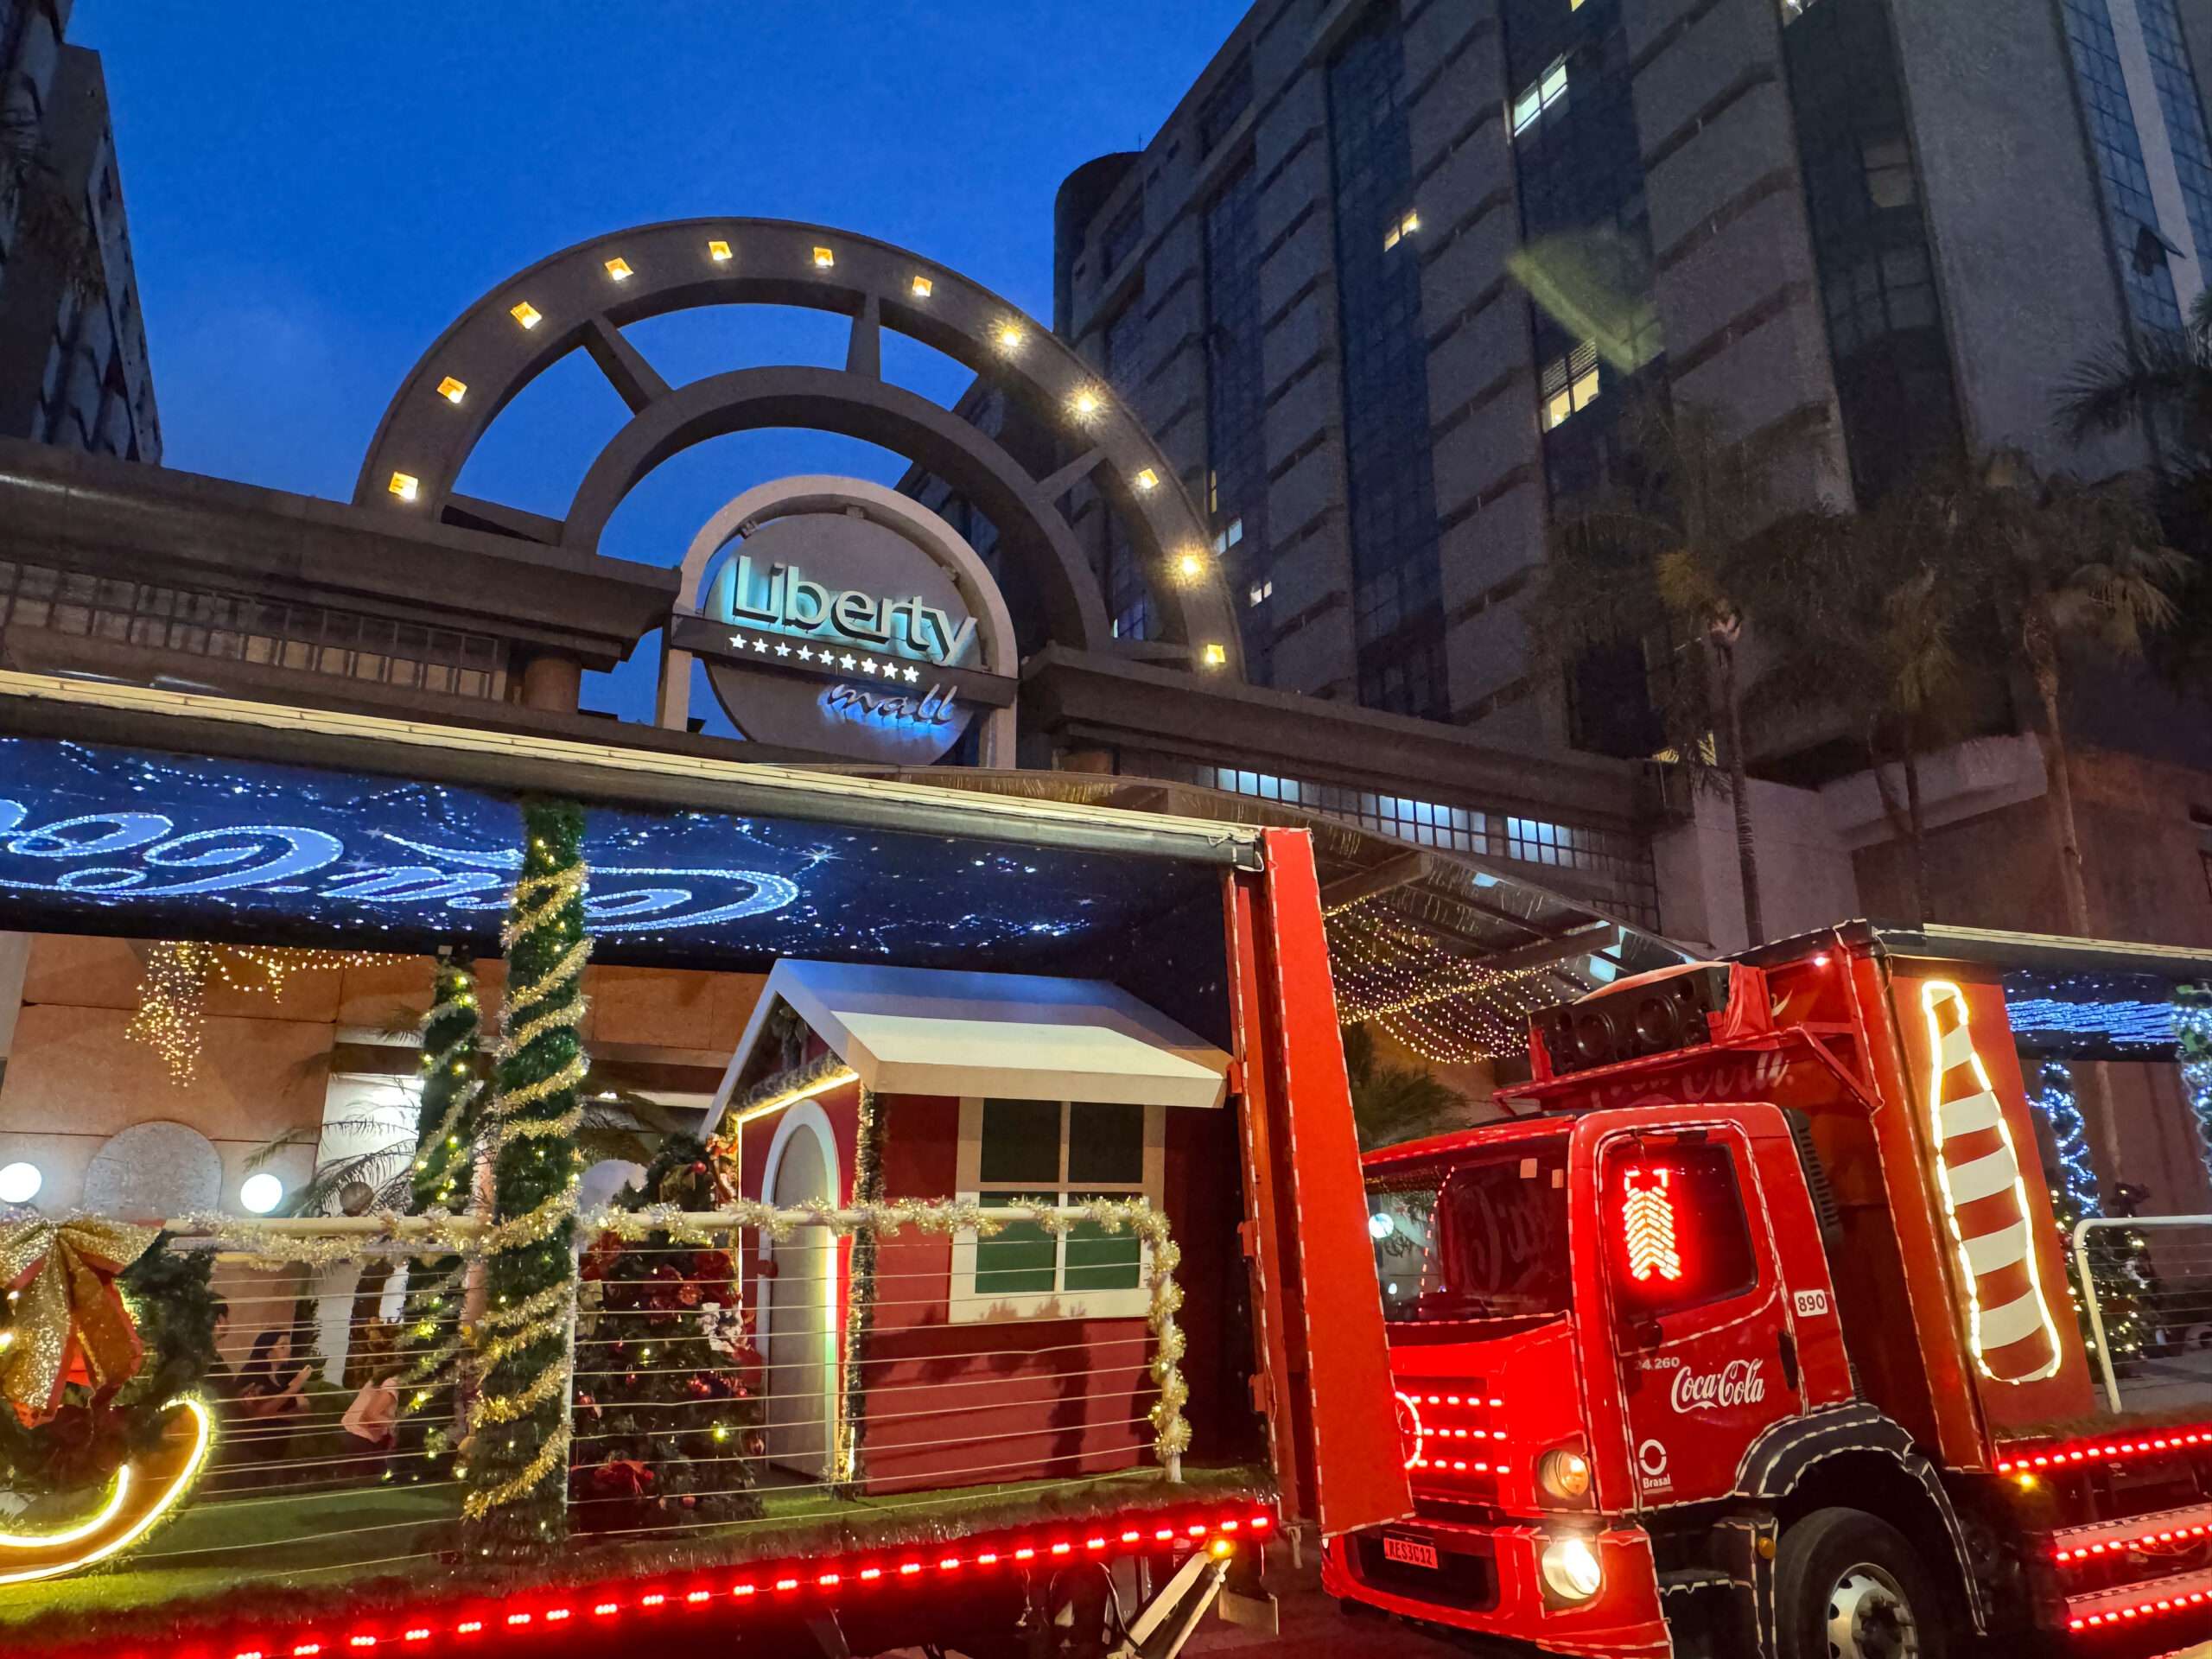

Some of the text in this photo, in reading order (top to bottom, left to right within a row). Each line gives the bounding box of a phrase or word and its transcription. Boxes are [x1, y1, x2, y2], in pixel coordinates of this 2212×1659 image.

[733, 556, 978, 662] Liberty
[828, 684, 957, 725] mall
[1797, 1294, 1825, 1313] 890
[1671, 1358, 1764, 1413] Coca-Cola
[1643, 1472, 1671, 1489] Brasal
